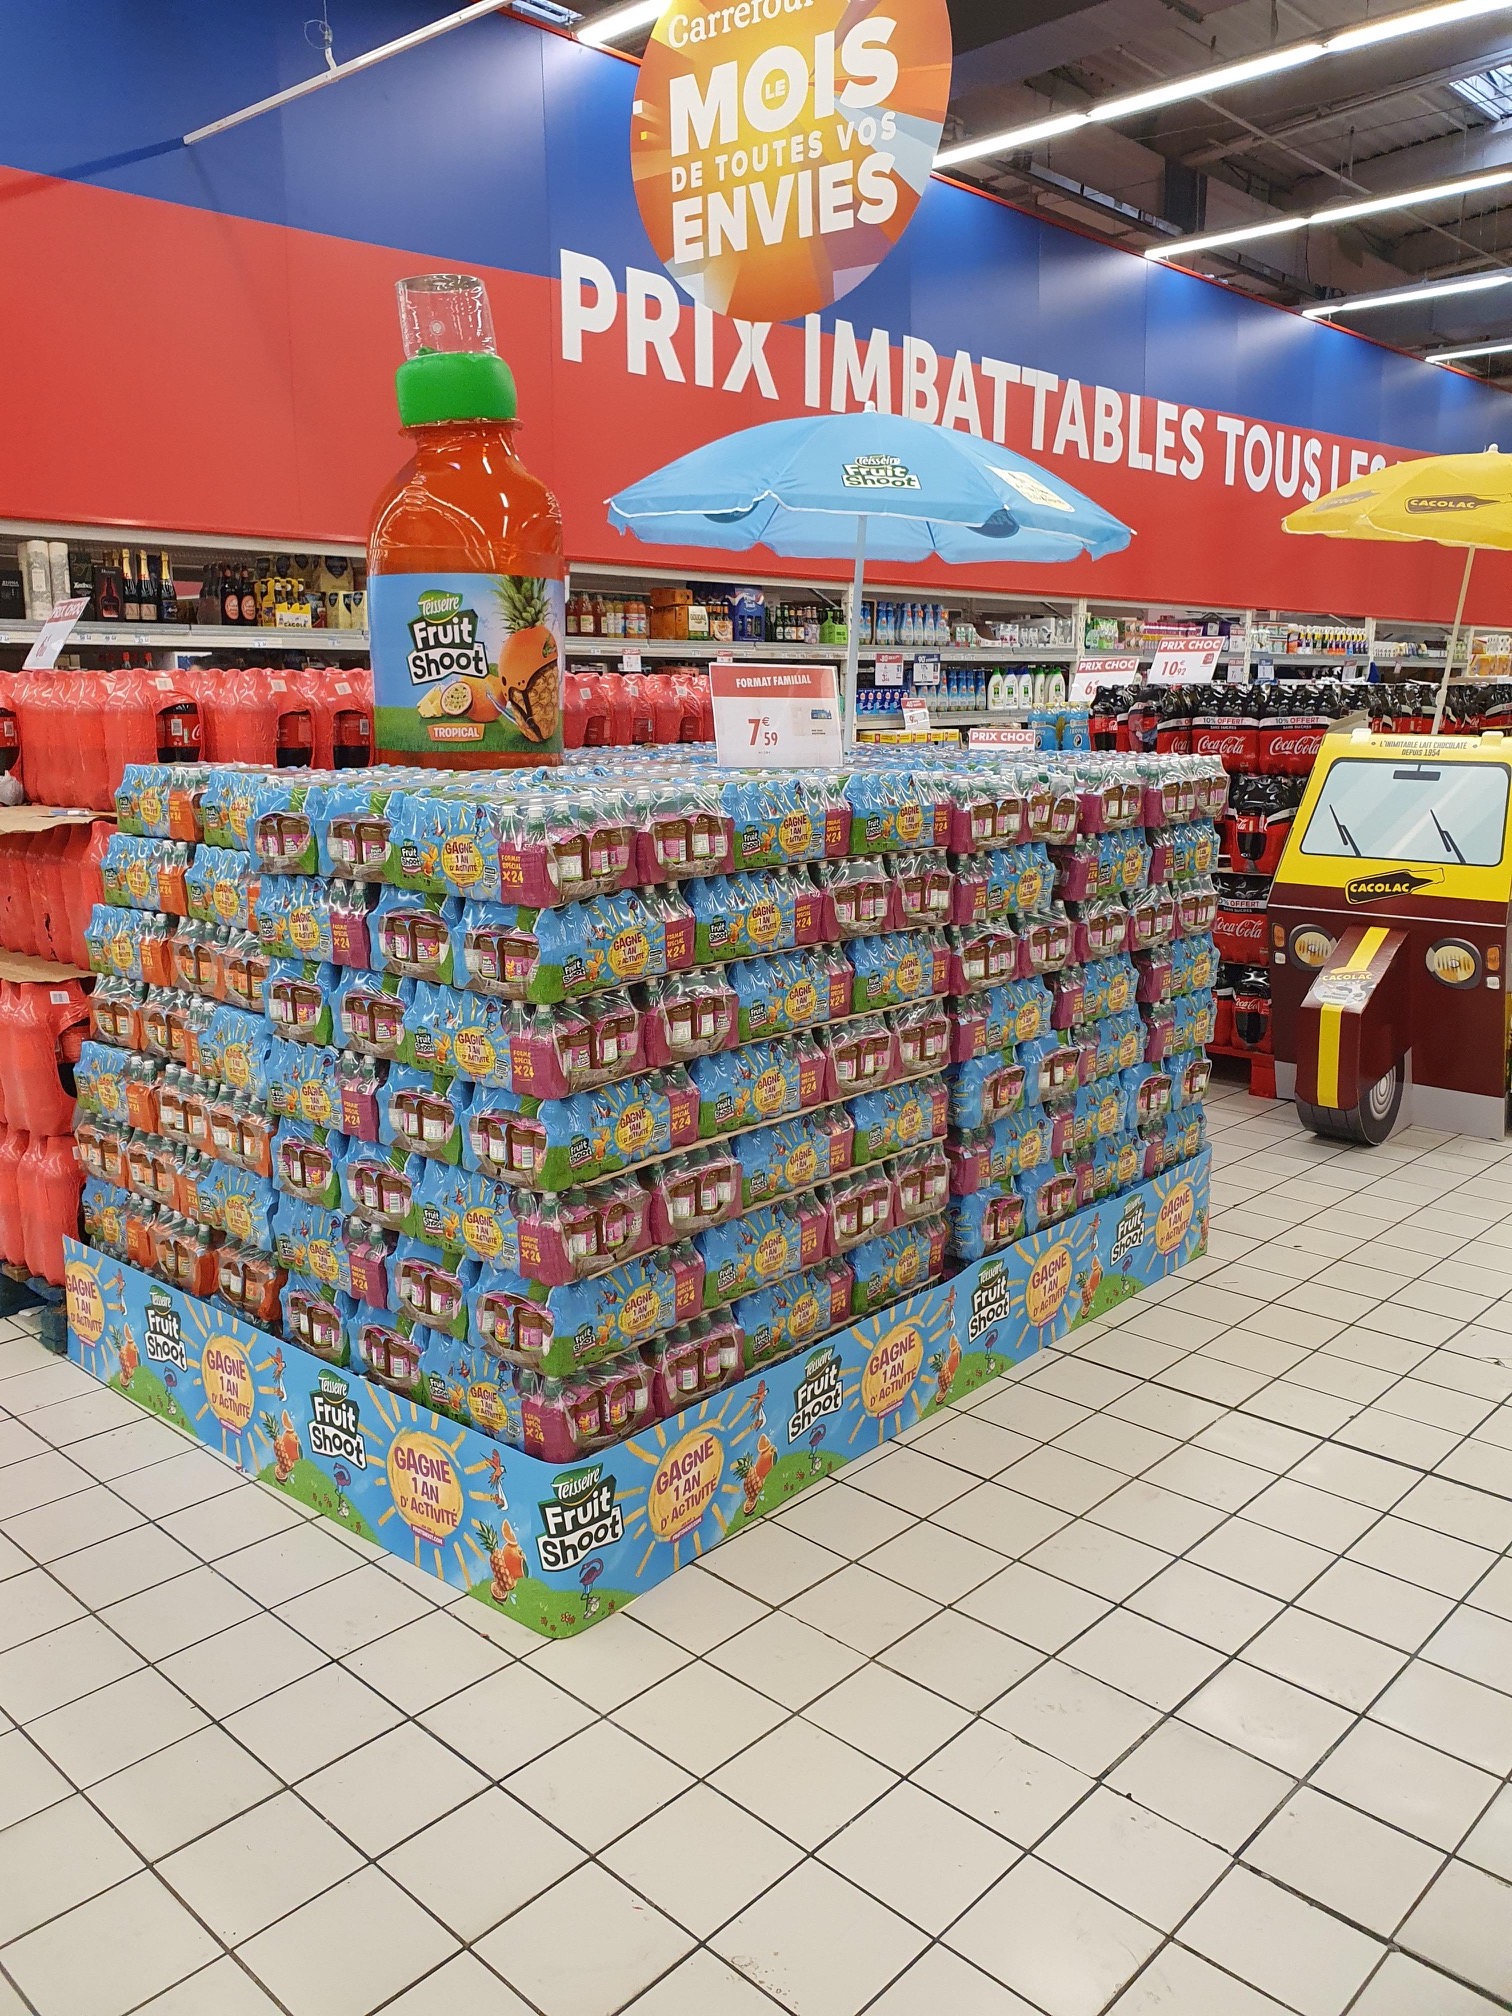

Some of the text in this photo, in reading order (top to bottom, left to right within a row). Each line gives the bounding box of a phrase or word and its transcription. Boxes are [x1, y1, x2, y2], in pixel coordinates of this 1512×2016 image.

[668, 0, 814, 49] Carrefou
[669, 16, 899, 158] MOIS
[765, 79, 786, 100] LE
[671, 110, 896, 193] DE TOUTES VOS
[672, 152, 898, 265] ENVIES
[560, 248, 780, 401] PRIX
[803, 313, 1206, 481] IMBATTABLES
[1216, 414, 1323, 503] TOUS
[843, 464, 907, 477] Fruit
[845, 475, 917, 487] Shoot
[1410, 499, 1475, 509] CACOLAC
[418, 594, 460, 617] Teisseire
[412, 617, 473, 649] Fruit
[1160, 639, 1221, 651] PRIX CHOC
[412, 650, 484, 680] Shoot
[1079, 659, 1136, 671] PRIX CHOC
[736, 674, 812, 689] FORMAT FAMILIAL
[433, 726, 480, 738] TROPICAL
[972, 732, 1034, 742] PRIX CHOC
[1419, 741, 1432, 749] LAIT
[1423, 749, 1441, 757] 1954
[783, 815, 807, 829] GAGNE
[445, 841, 473, 854] GAGNE
[1350, 883, 1410, 893] CACOLAC
[752, 904, 775, 918] GAGNE
[613, 932, 642, 951] GAGNE
[789, 984, 812, 1000] GAGNE
[757, 1072, 781, 1090] GAGNE
[620, 1108, 647, 1129] GAGNE
[1161, 1189, 1190, 1220] GAGNE
[466, 1212, 493, 1228] GAGNE
[1118, 1208, 1143, 1240] Fruit
[1112, 1228, 1143, 1262] Shoot
[1032, 1251, 1067, 1289] GAGNE
[1047, 1275, 1059, 1294] AN
[66, 1275, 97, 1300] GAGNE
[624, 1289, 653, 1313] GAGNE
[973, 1275, 1007, 1313] Fruit
[147, 1309, 179, 1340] Fruit
[970, 1297, 1009, 1338] Shoot
[147, 1335, 185, 1369] Shoot
[206, 1350, 247, 1382] GAGNE
[869, 1331, 916, 1376] GAGNE
[889, 1357, 904, 1380] AN
[226, 1378, 239, 1399] AN
[797, 1364, 838, 1409] Fruit
[314, 1396, 356, 1432] Fruit
[791, 1387, 842, 1438] Shoot
[312, 1425, 365, 1466] Shoot
[394, 1446, 452, 1485] GAGNE
[656, 1436, 714, 1496] GAGNE
[411, 1476, 440, 1504] 1 AN
[550, 1466, 600, 1500] Teisseire
[673, 1470, 700, 1502] 1 AN
[544, 1485, 611, 1535] Fruit
[541, 1513, 620, 1567] Shoot
